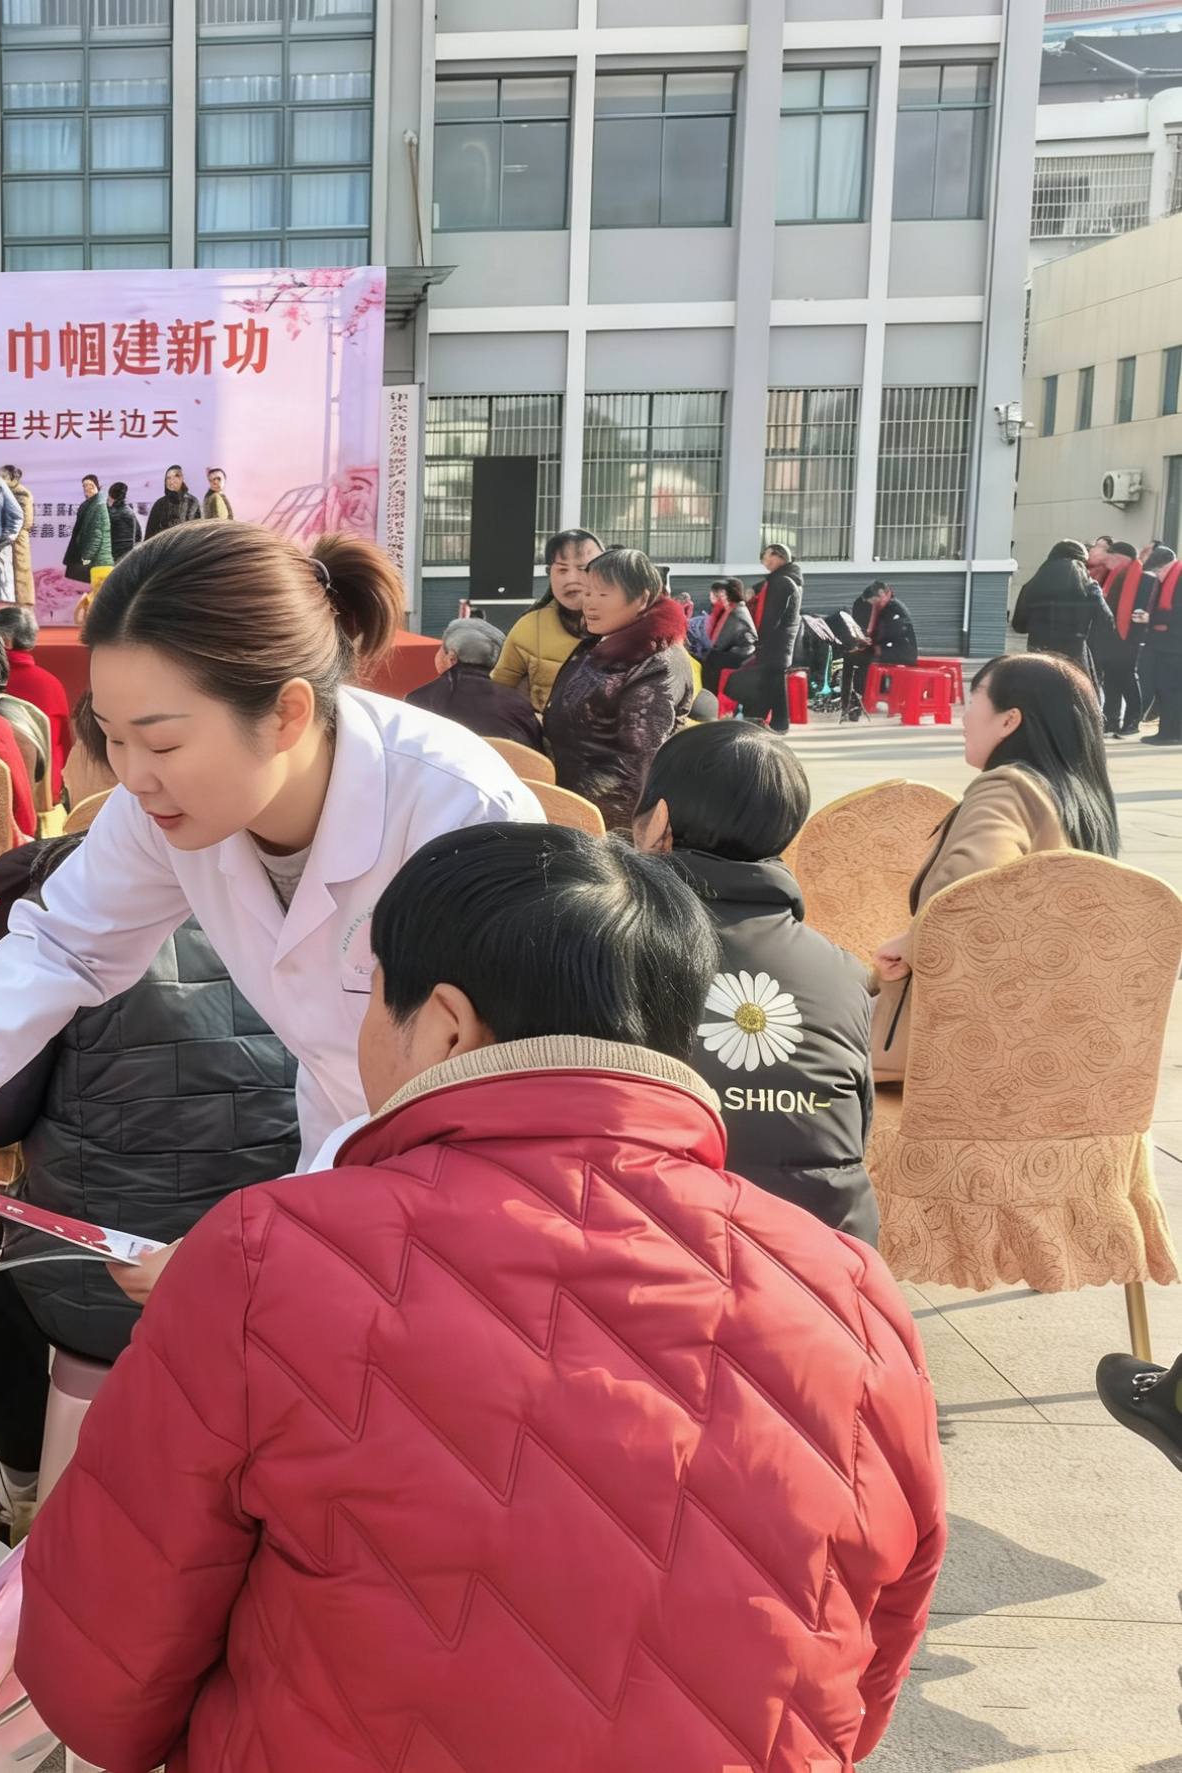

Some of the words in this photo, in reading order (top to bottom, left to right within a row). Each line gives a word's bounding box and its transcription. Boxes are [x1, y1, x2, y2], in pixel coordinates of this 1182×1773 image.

[7, 319, 270, 379] 巾帼建新功
